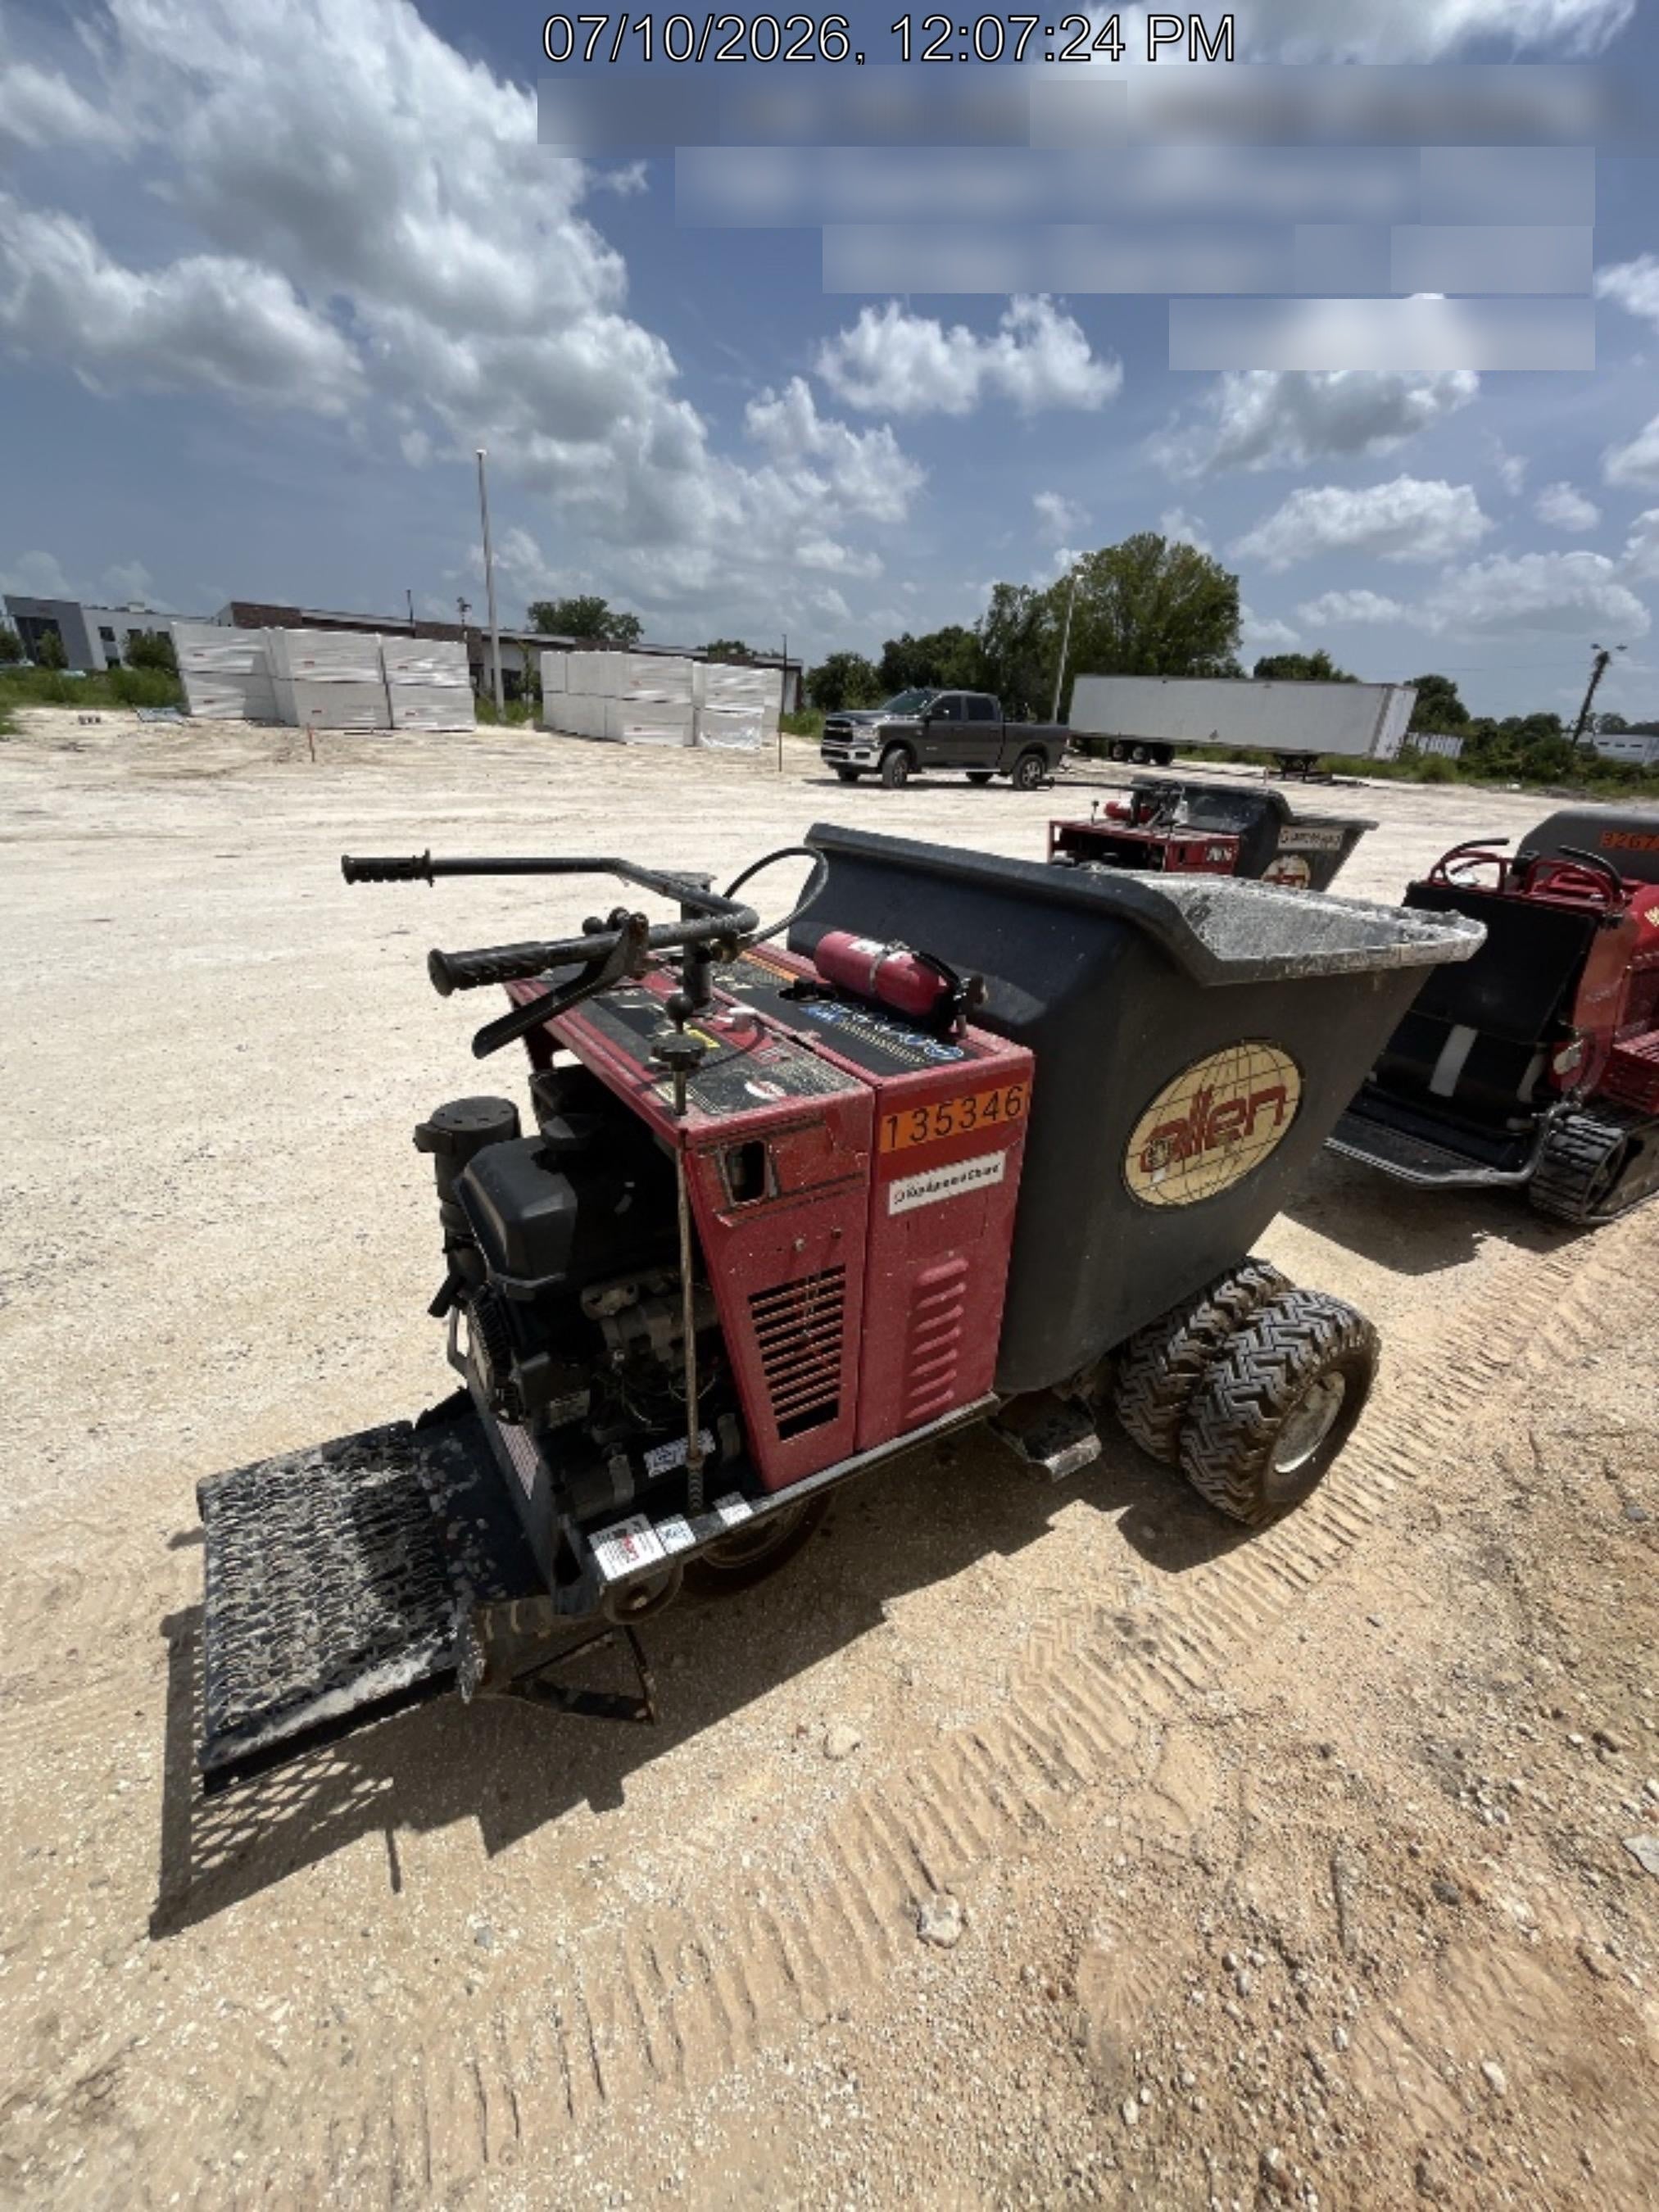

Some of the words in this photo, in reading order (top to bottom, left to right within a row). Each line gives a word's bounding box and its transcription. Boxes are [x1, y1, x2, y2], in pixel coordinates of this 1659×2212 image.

[1602, 831, 1659, 851] 3267
[886, 1086, 1023, 1149] 135346
[1140, 1083, 1287, 1173] allen
